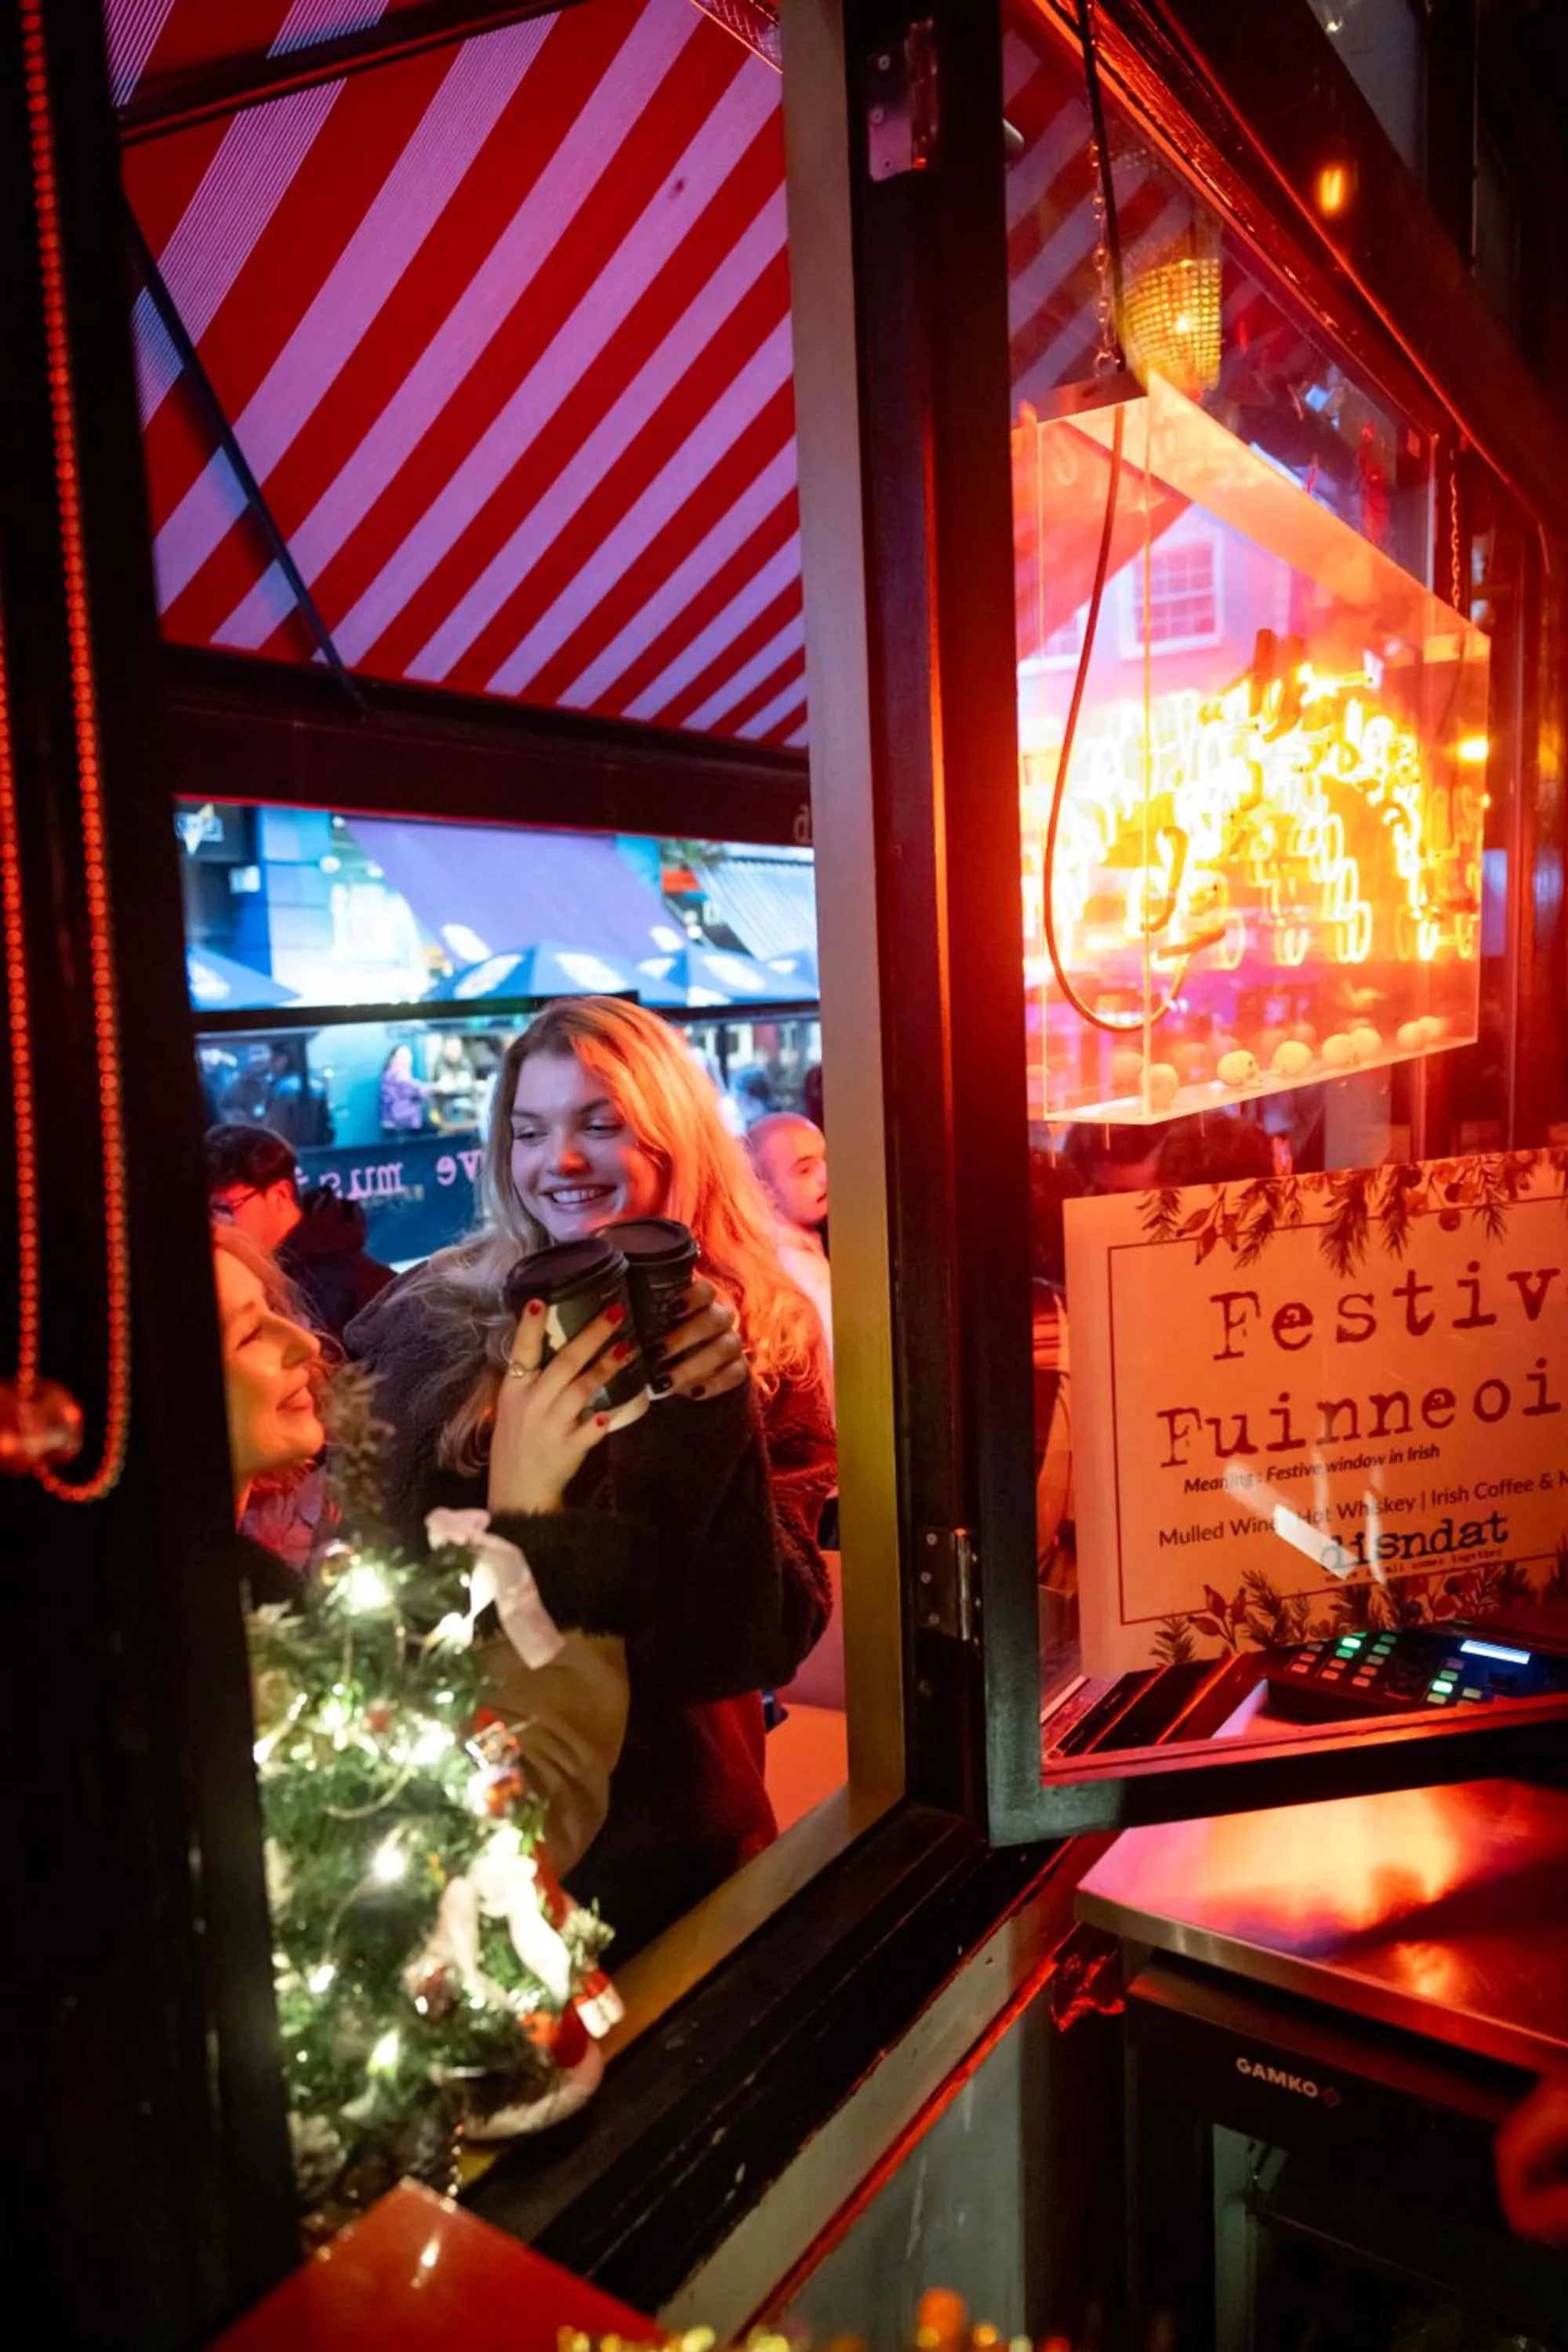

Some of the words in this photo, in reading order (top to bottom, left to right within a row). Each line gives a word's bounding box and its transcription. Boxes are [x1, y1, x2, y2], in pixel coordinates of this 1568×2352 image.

[1210, 1261, 1568, 1360] Festiv
[1157, 1358, 1561, 1468] Fuinneoi
[1266, 1461, 1322, 1482] Festive
[1326, 1450, 1386, 1473] window
[1388, 1446, 1403, 1464] in
[1407, 1443, 1440, 1461] Irish
[1159, 1522, 1225, 1548] Mulled
[1337, 1495, 1416, 1520] Whskey
[1432, 1486, 1468, 1505] Irish
[1474, 1477, 1534, 1501] Coffee
[1539, 1472, 1553, 1490] &
[1321, 1511, 1508, 1570] disndat
[1236, 2056, 1319, 2098] GAMKO
